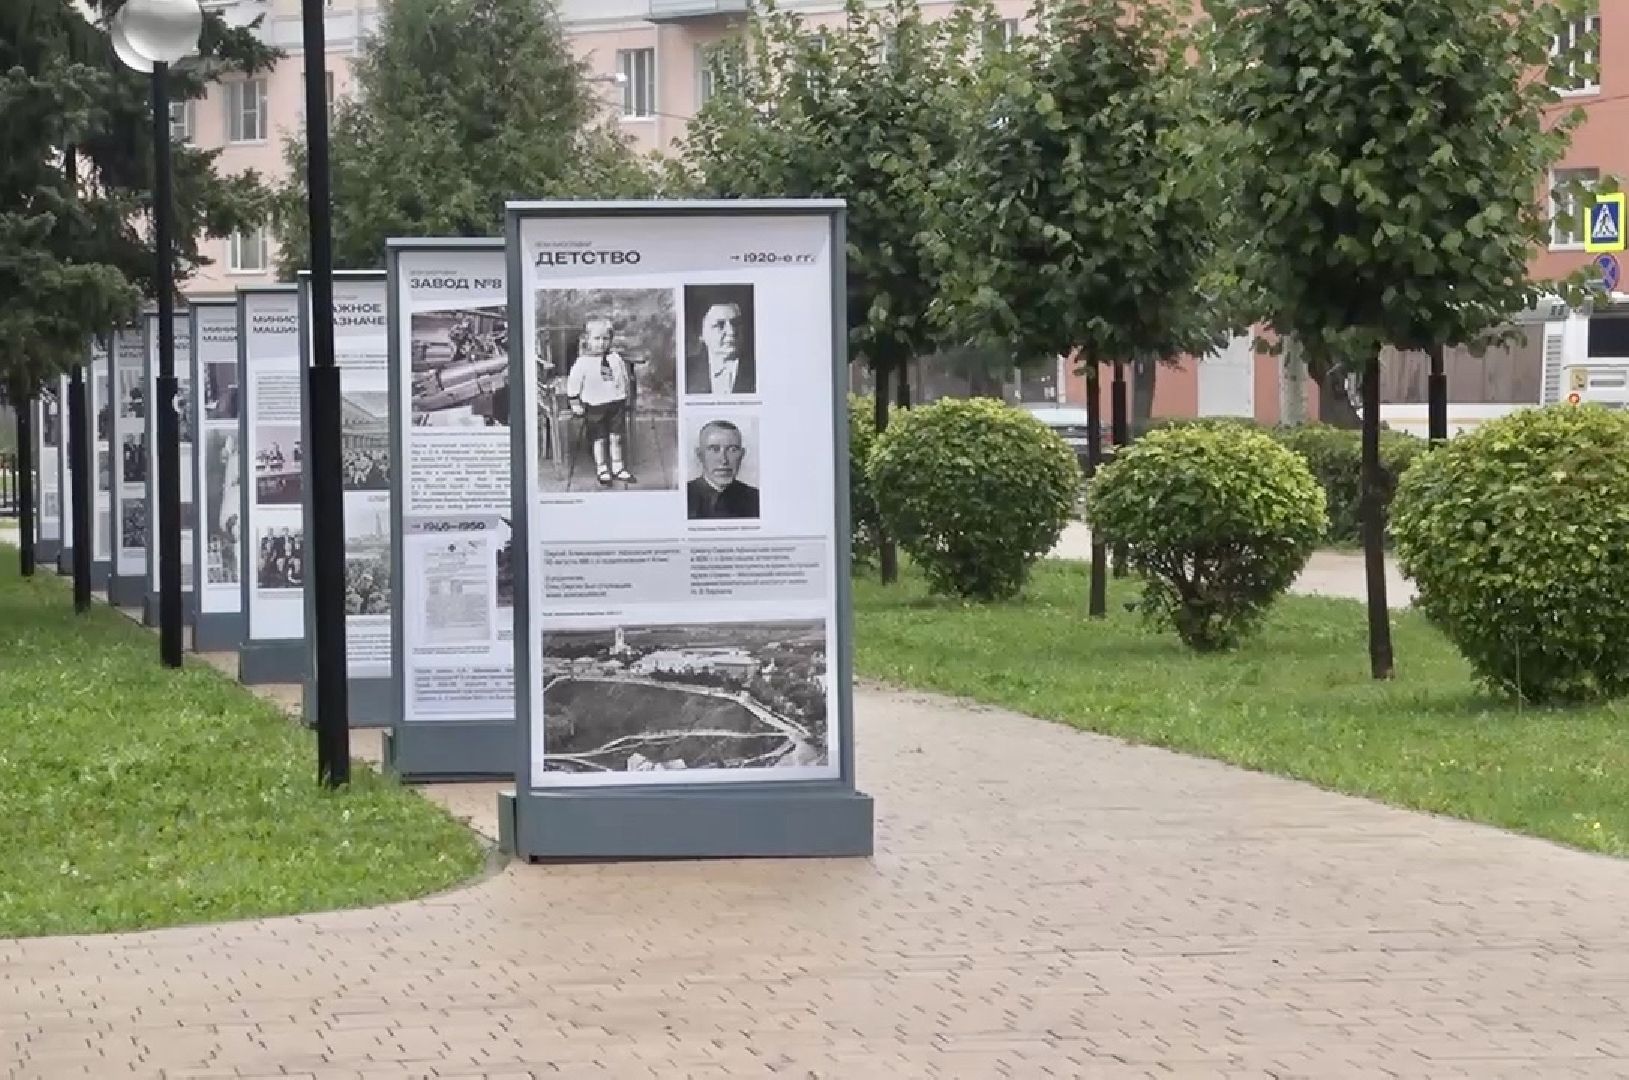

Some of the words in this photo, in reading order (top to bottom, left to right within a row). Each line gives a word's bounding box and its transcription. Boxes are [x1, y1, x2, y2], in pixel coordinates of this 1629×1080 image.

[535, 251, 641, 266] ДЕТСТВО
[743, 252, 792, 263] 1920-е
[410, 278, 469, 290] ЗАВОД
